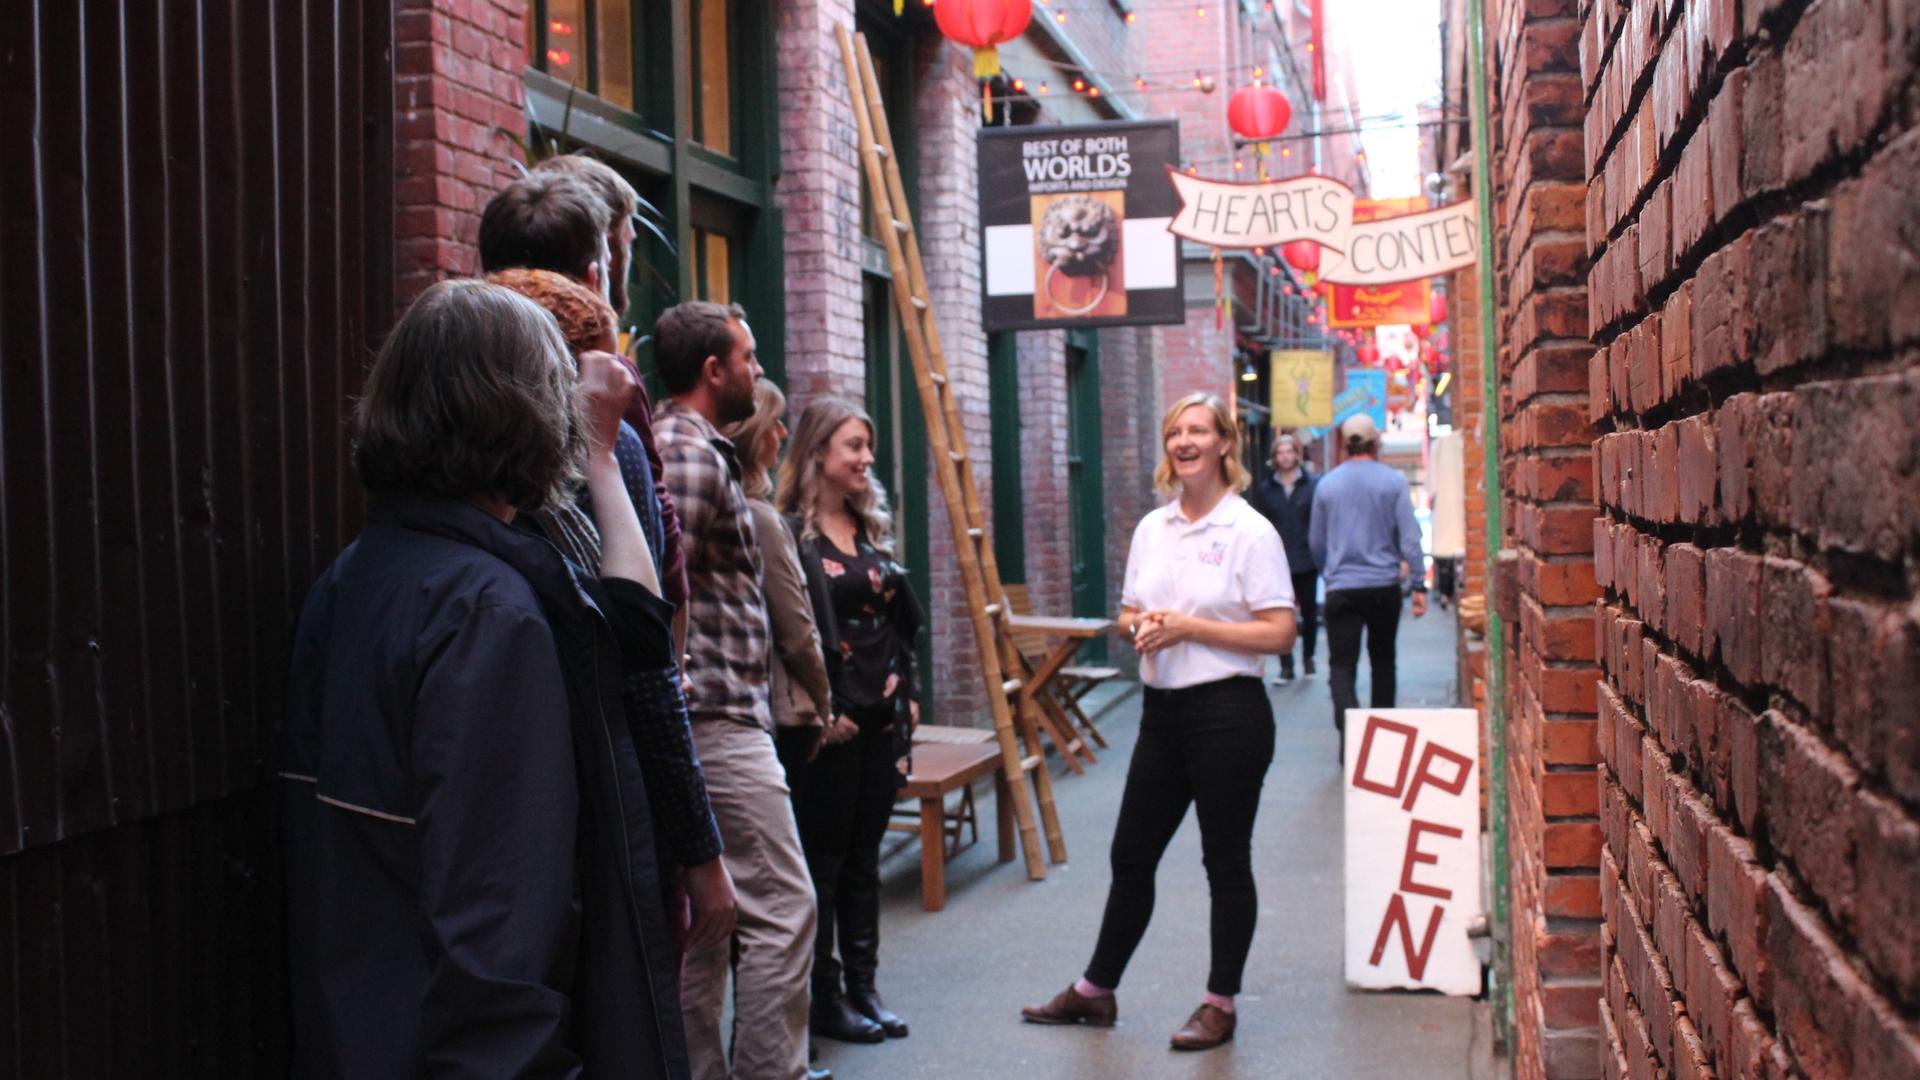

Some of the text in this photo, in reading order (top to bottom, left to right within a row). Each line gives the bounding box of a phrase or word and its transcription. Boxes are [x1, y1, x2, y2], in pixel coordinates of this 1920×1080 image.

[1022, 136, 1128, 158] BEST OF BOTH
[1022, 152, 1132, 182] WORLDS
[1193, 184, 1341, 235] HEART'S
[1353, 716, 1473, 982] OPEN
